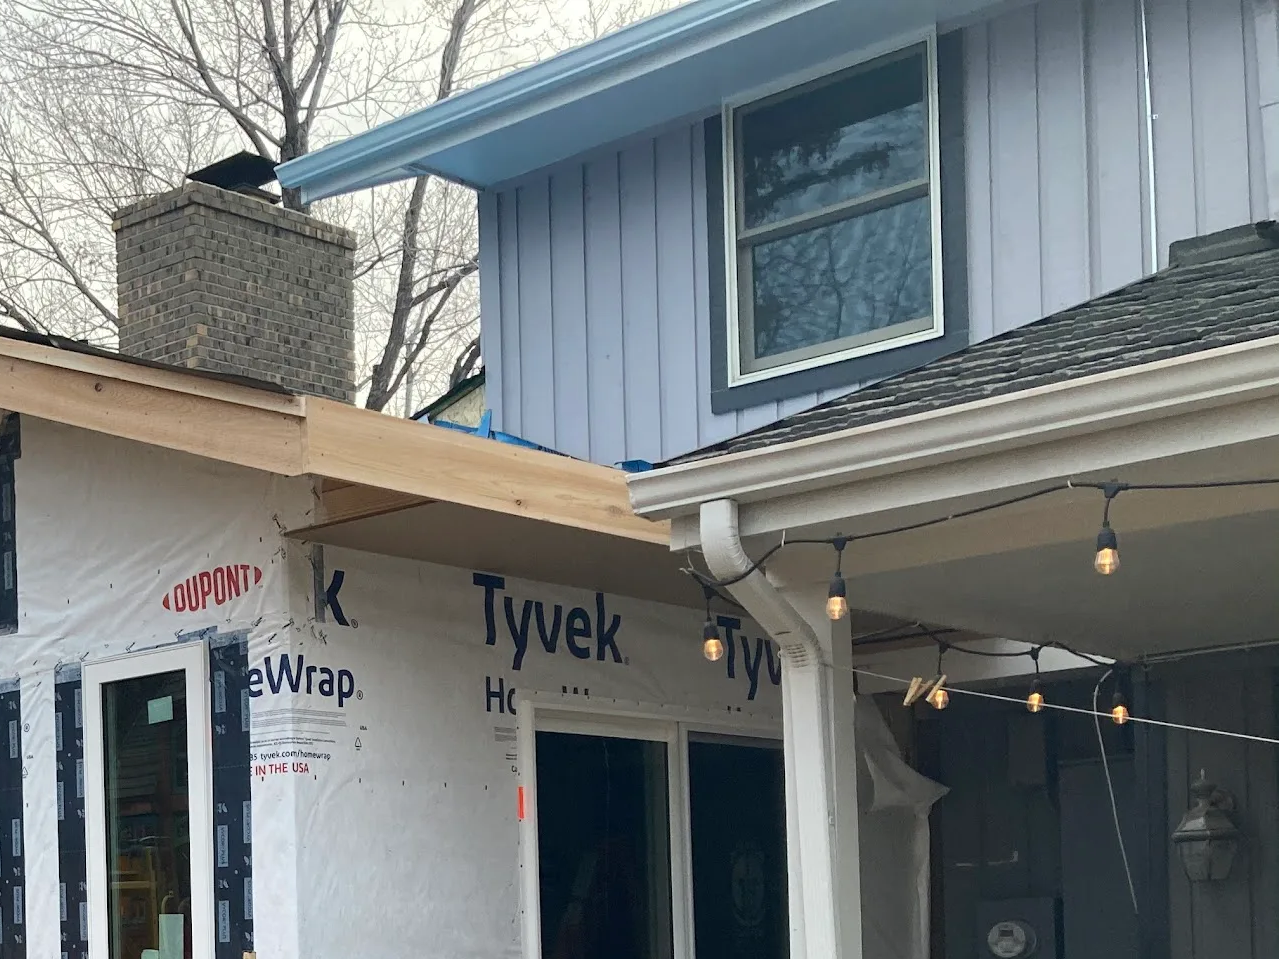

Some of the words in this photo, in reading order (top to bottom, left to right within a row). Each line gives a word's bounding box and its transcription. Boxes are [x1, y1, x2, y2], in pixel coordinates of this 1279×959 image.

[174, 564, 250, 612] DUPONT
[472, 572, 623, 671] Tyvek
[248, 654, 355, 707] eWrap
[255, 765, 266, 776] IN
[268, 763, 288, 775] THE
[292, 762, 310, 774] USA
[260, 749, 331, 761] tyvek.com/homewrap
